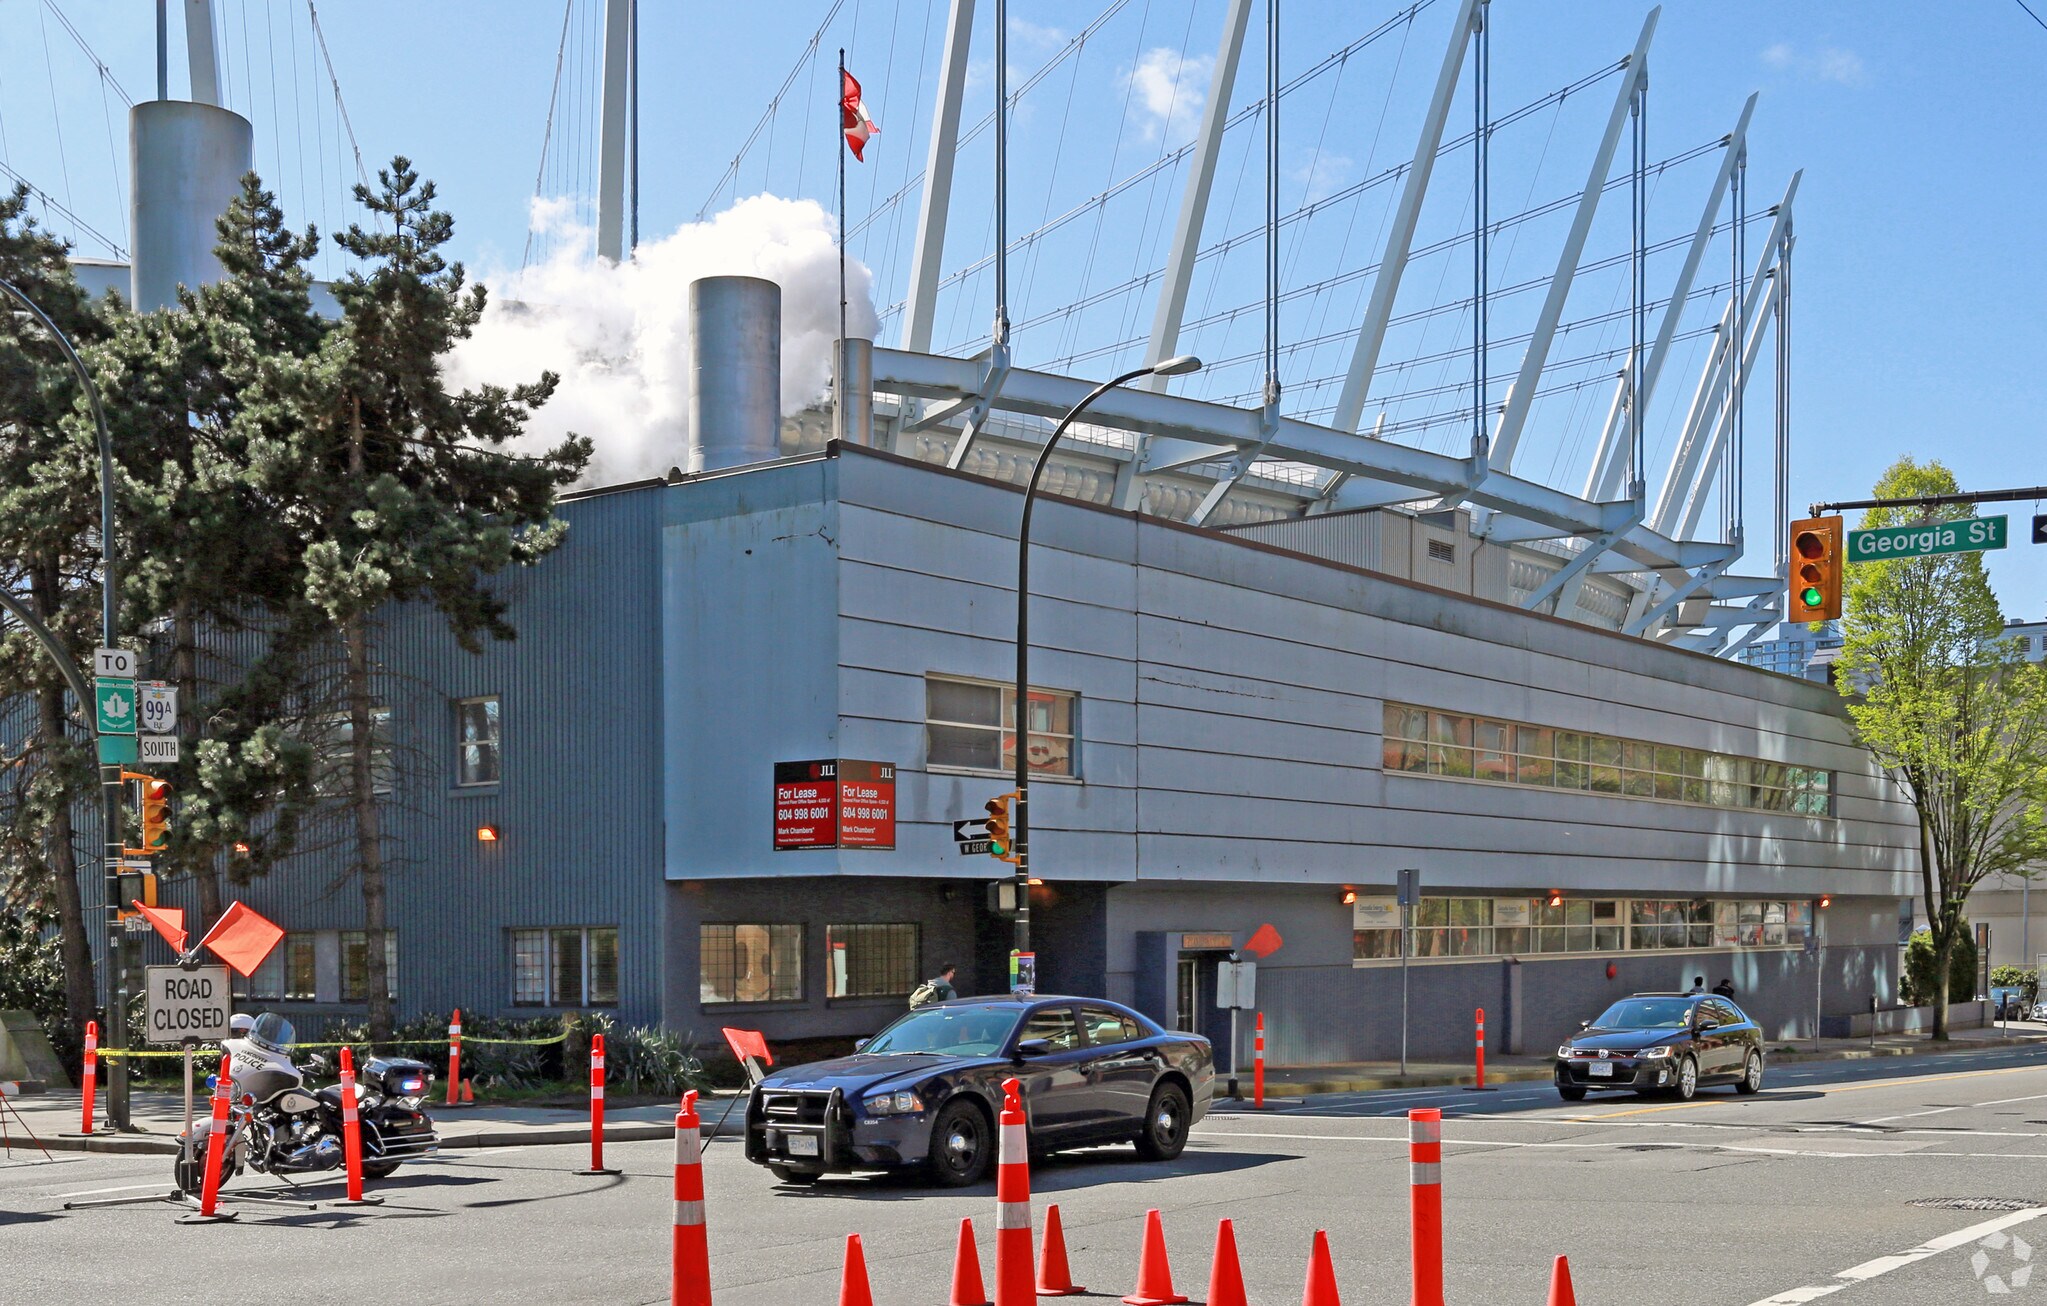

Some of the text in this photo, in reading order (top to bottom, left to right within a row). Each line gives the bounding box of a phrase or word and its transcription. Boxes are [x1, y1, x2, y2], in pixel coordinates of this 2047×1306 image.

[1857, 521, 1996, 554] Georgia St
[101, 654, 127, 671] TO
[146, 700, 172, 721] 99A
[143, 741, 176, 757] SOUTH
[820, 765, 835, 777] JLL
[880, 767, 893, 779] JLL
[778, 787, 817, 799] For Lease
[843, 785, 878, 799] For Lease
[778, 807, 829, 821] 604 998 6001
[842, 807, 887, 820] 604 998 6001
[964, 844, 970, 853] W
[165, 978, 212, 1000] ROAD
[154, 1007, 224, 1030] CLOSED
[233, 1052, 265, 1071] POLICE
[241, 1049, 268, 1063] VANCOUVER
